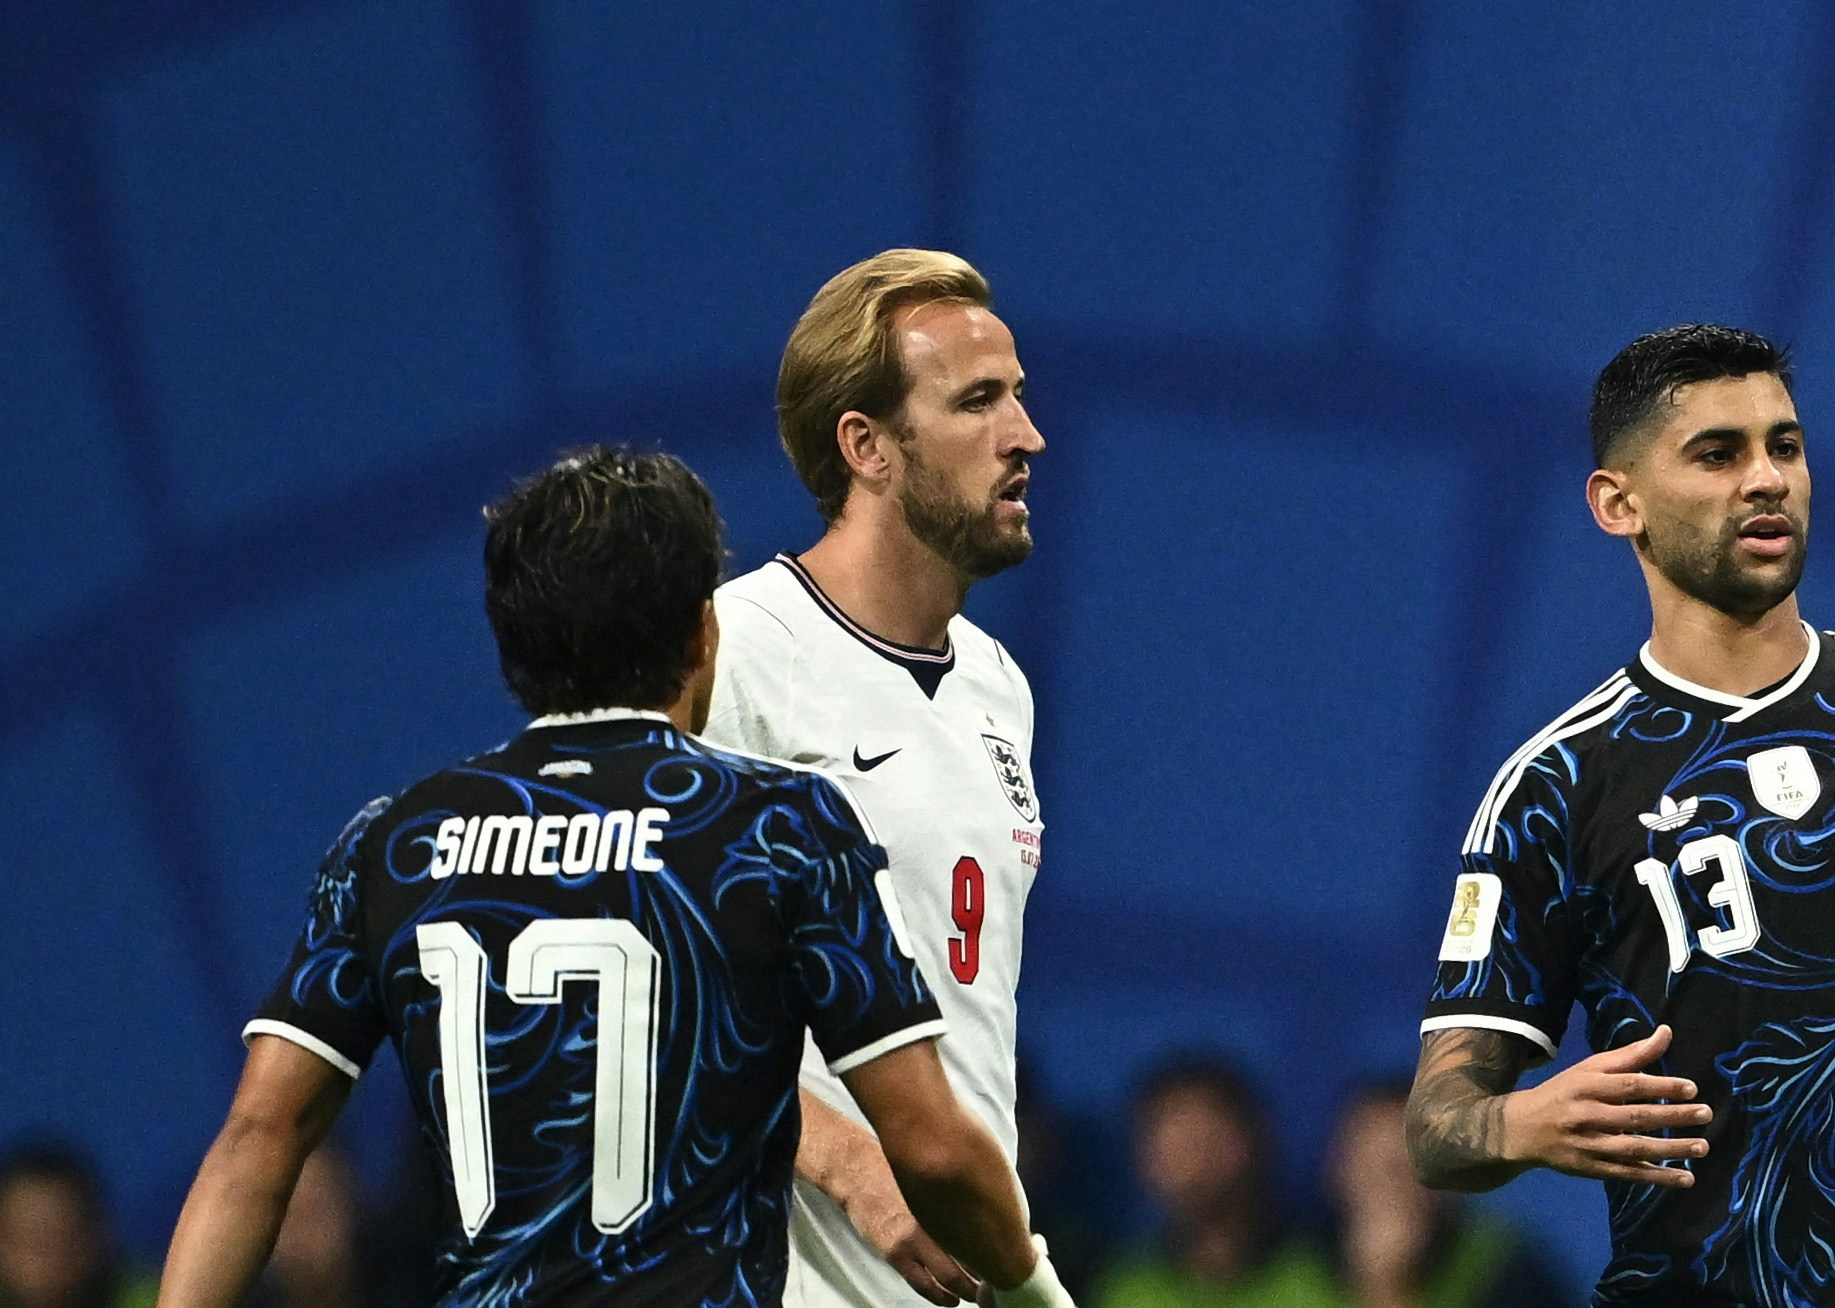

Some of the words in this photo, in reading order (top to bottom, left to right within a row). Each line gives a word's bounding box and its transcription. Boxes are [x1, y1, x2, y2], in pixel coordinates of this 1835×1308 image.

[431, 807, 671, 880] SIMEONE
[1634, 834, 1761, 973] 13
[948, 855, 985, 986] 9
[415, 918, 662, 1239] 17
